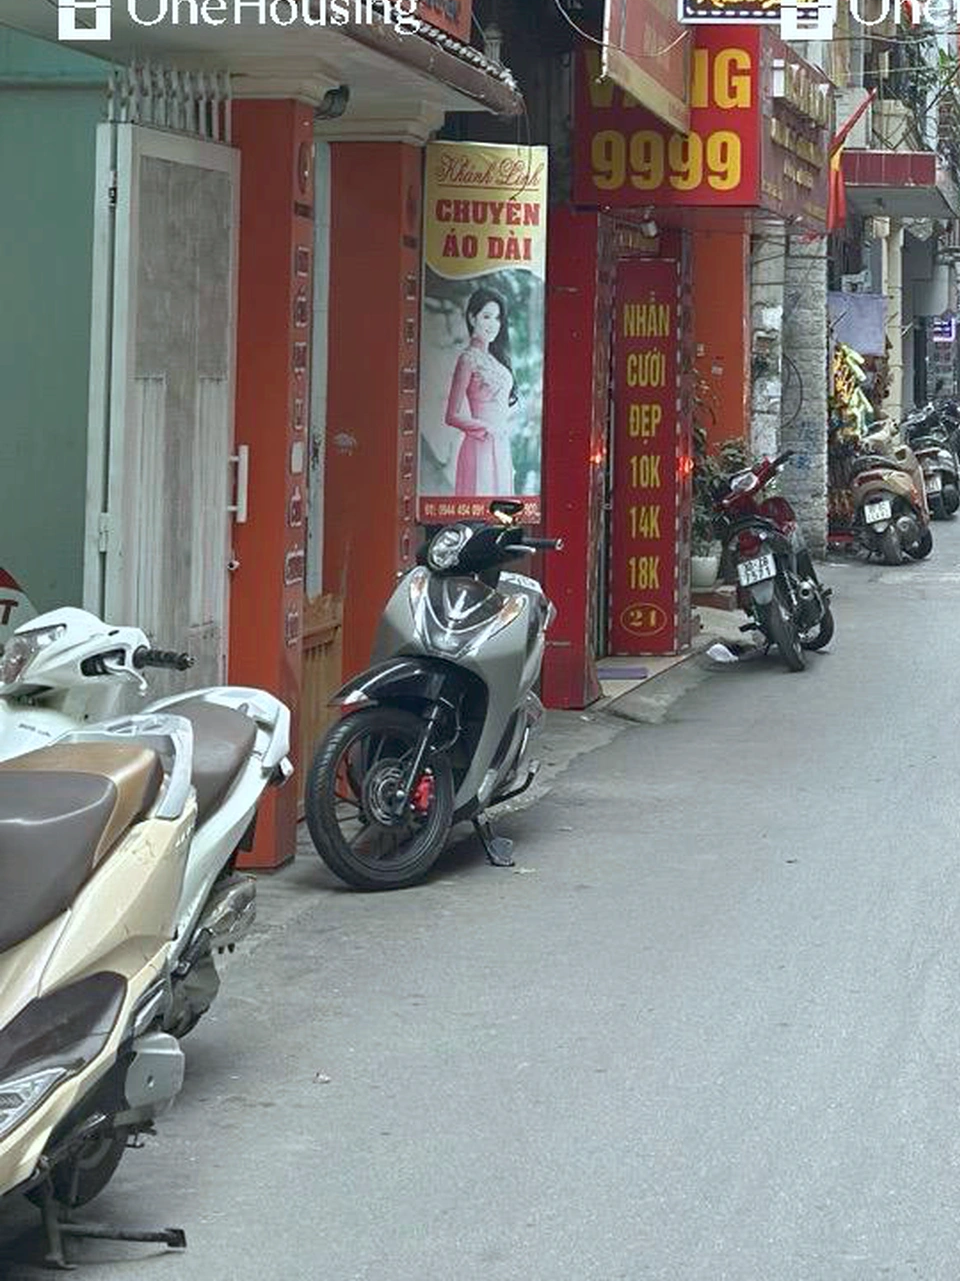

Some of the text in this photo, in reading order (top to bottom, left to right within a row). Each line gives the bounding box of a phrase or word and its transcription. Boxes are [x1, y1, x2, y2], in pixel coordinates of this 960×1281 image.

[591, 130, 741, 191] 9999
[435, 198, 541, 226] CHUYÊN
[442, 227, 532, 261] ÁO DÀI
[630, 404, 661, 445] ĐẸP
[630, 456, 661, 488] 10K
[629, 508, 660, 539] 14K
[629, 557, 660, 589] 18K
